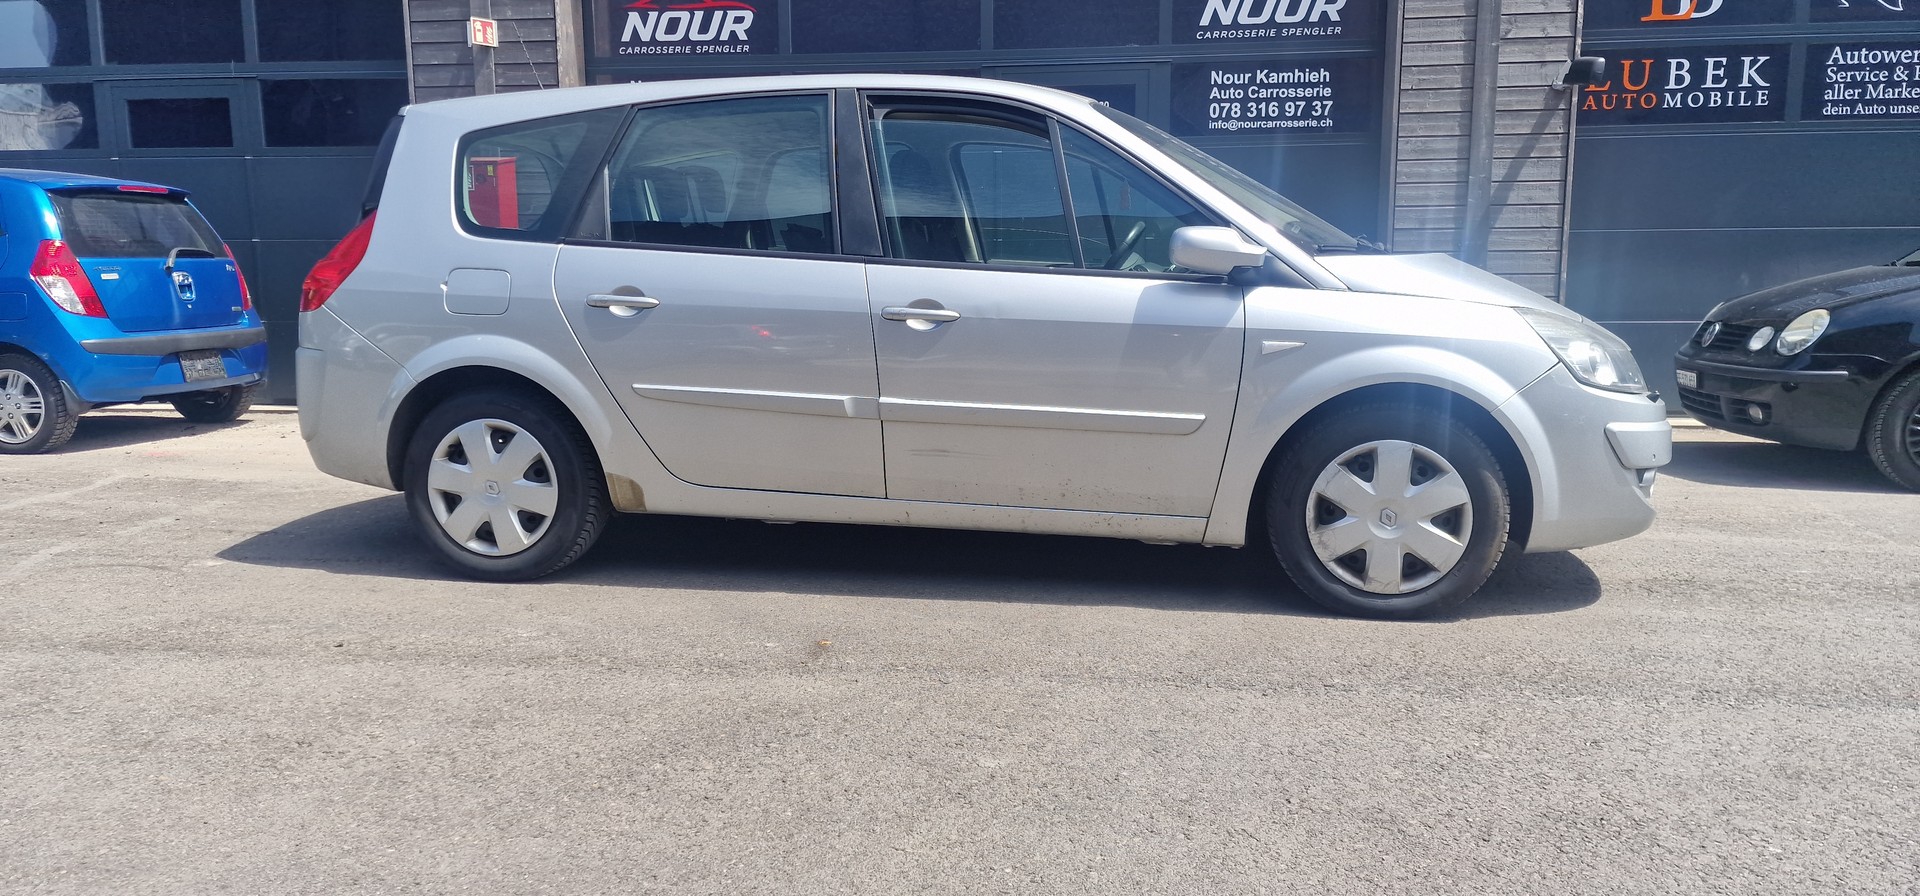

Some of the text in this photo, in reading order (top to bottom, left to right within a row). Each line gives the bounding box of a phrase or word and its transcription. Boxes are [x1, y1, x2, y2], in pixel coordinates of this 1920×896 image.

[1198, 0, 1347, 27] NOUR
[620, 9, 754, 42] NOUR
[1196, 26, 1342, 40] CARROSSERIE SPENGLER
[619, 44, 750, 55] CARROSSERIE SPENGLER
[1210, 68, 1330, 85] Nour Kamhieh
[1825, 66, 1889, 82] Service
[1893, 65, 1910, 81] &
[1209, 84, 1332, 99] Auto Carrosserie
[1824, 82, 1920, 100] aller Marke
[1209, 100, 1333, 119] 078 316 97 37
[1822, 102, 1851, 115] dein
[1853, 102, 1886, 115] Auto
[1208, 117, 1333, 131] info@nourcarrosserie.ch
